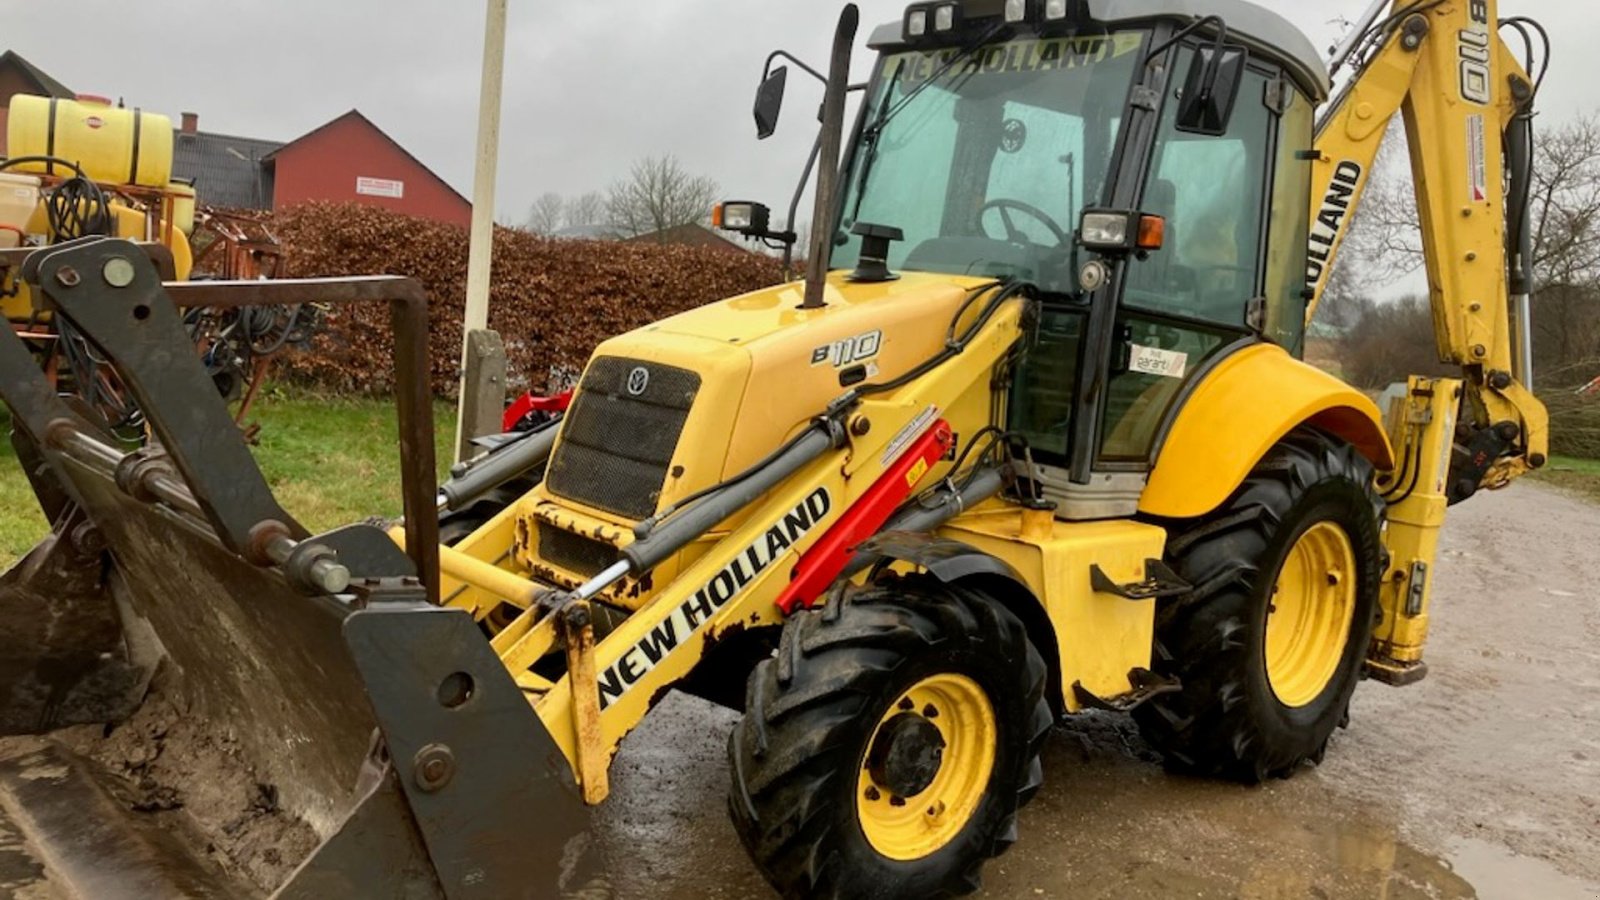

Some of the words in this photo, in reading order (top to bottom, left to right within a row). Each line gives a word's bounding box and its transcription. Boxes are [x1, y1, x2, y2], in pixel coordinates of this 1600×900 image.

[1306, 160, 1361, 300] OLLAND
[598, 615, 678, 712] NEW
[681, 487, 831, 632] HOLLAND
